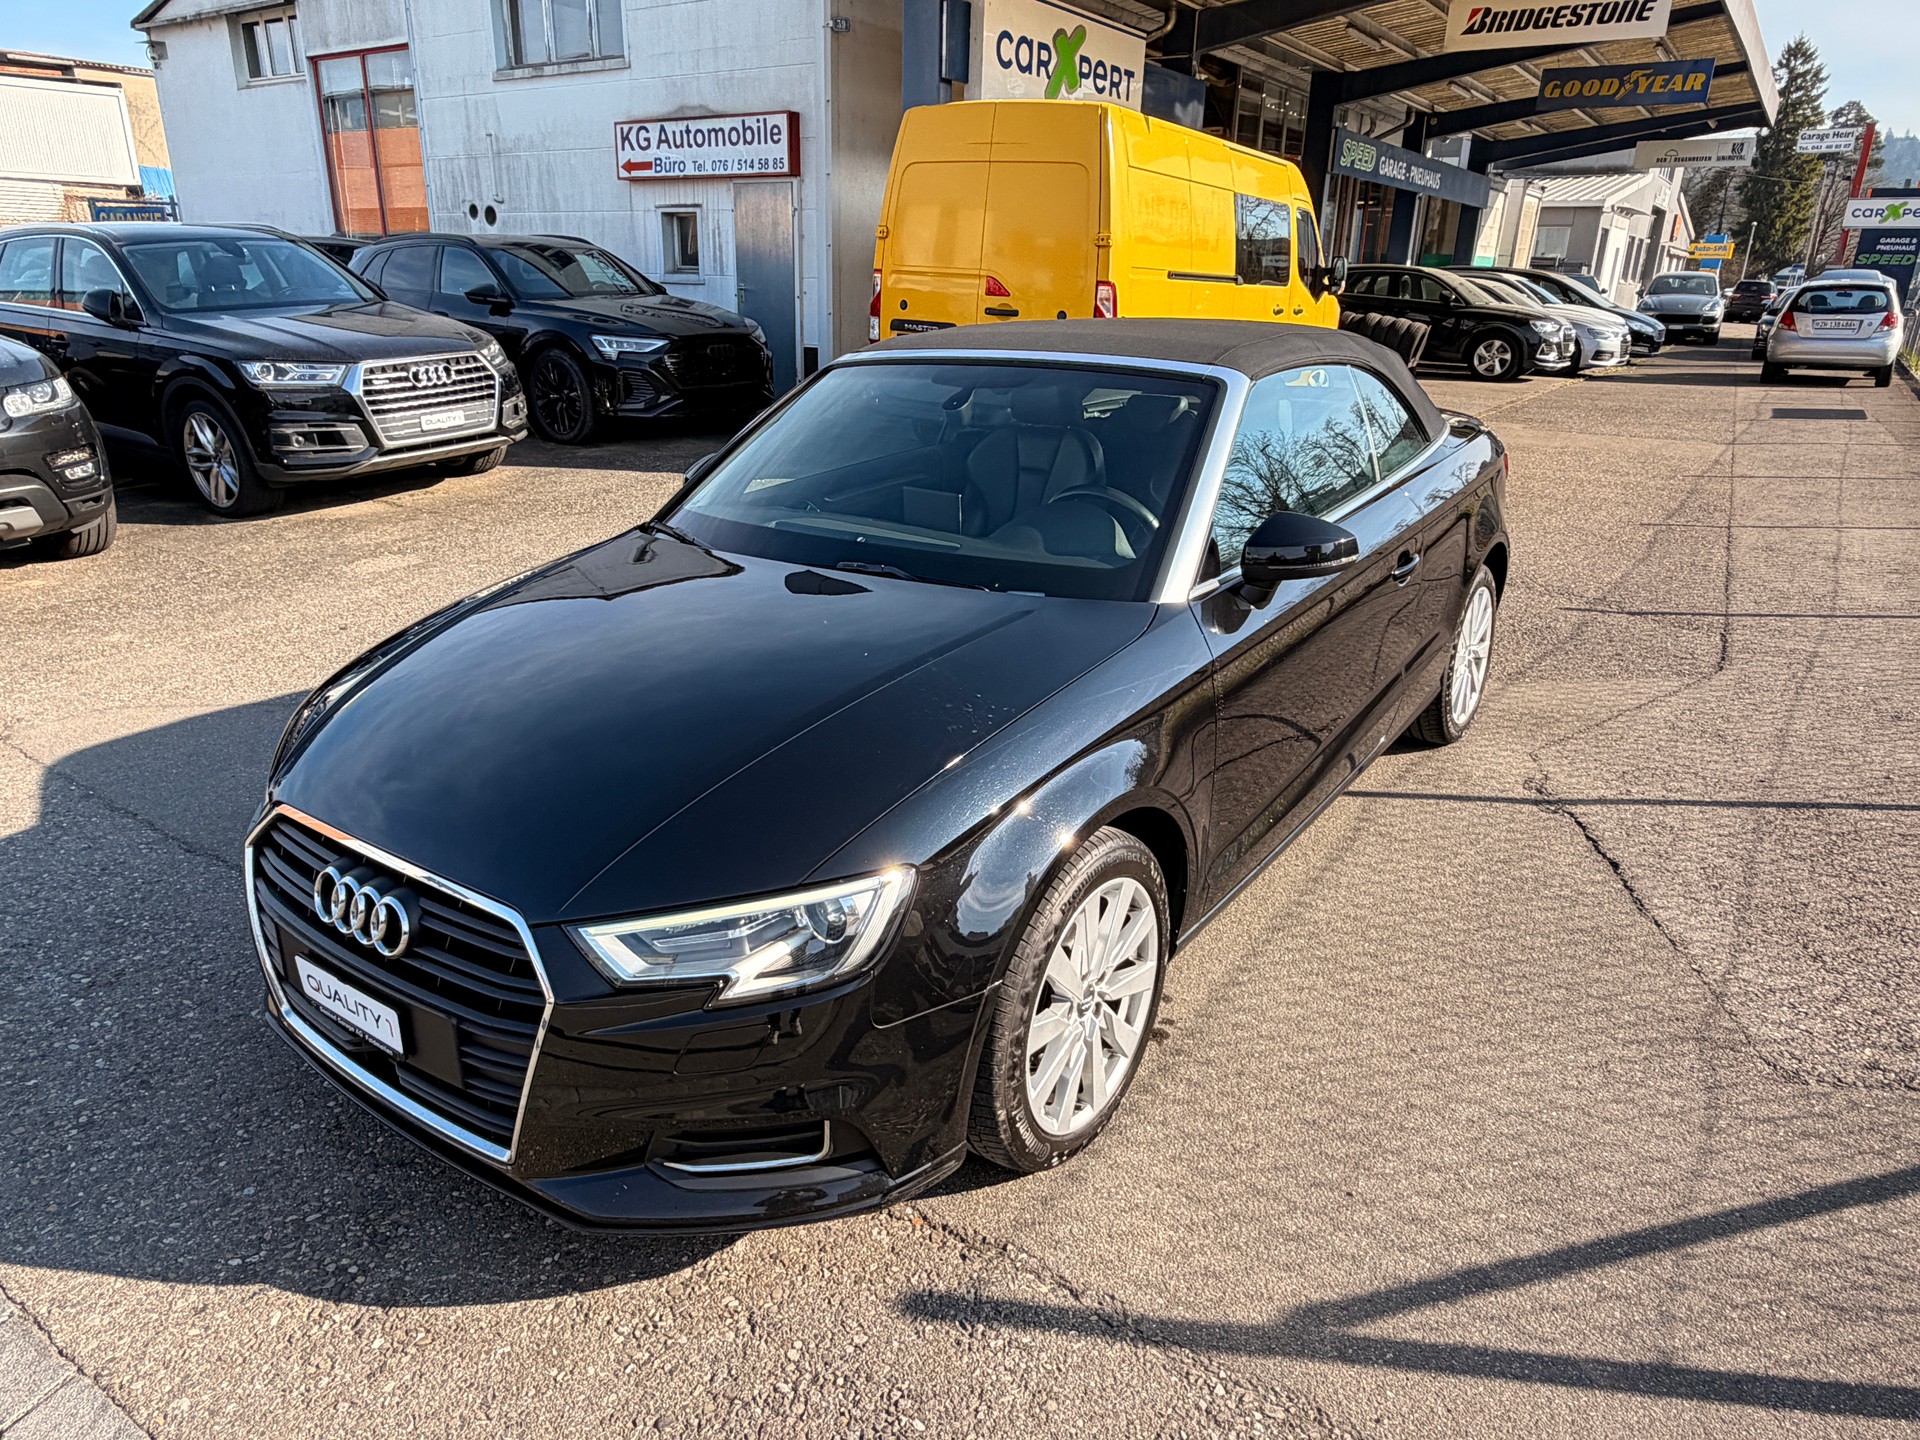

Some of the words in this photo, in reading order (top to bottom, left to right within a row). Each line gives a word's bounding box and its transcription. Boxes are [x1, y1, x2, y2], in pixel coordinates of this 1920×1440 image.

[1460, 0, 1655, 35] BRIDGESTONE
[1544, 70, 1706, 99] GOODYEAR
[620, 125, 651, 151] KG
[656, 117, 783, 150] Automobile
[1801, 132, 1830, 141] Garage
[654, 157, 686, 174] Büro
[692, 160, 708, 172] Tel.
[711, 160, 729, 171] 076
[737, 159, 754, 171] 514
[757, 158, 769, 170] 58
[772, 157, 785, 170] 85
[1340, 138, 1377, 172] SPEED
[1379, 156, 1407, 180] GARAGE
[1409, 165, 1441, 190] PNEUHAUS
[1855, 253, 1917, 265] SPEED
[425, 415, 457, 426] QUALITY
[307, 974, 381, 1029] QUALITY
[385, 1018, 394, 1038] 1
